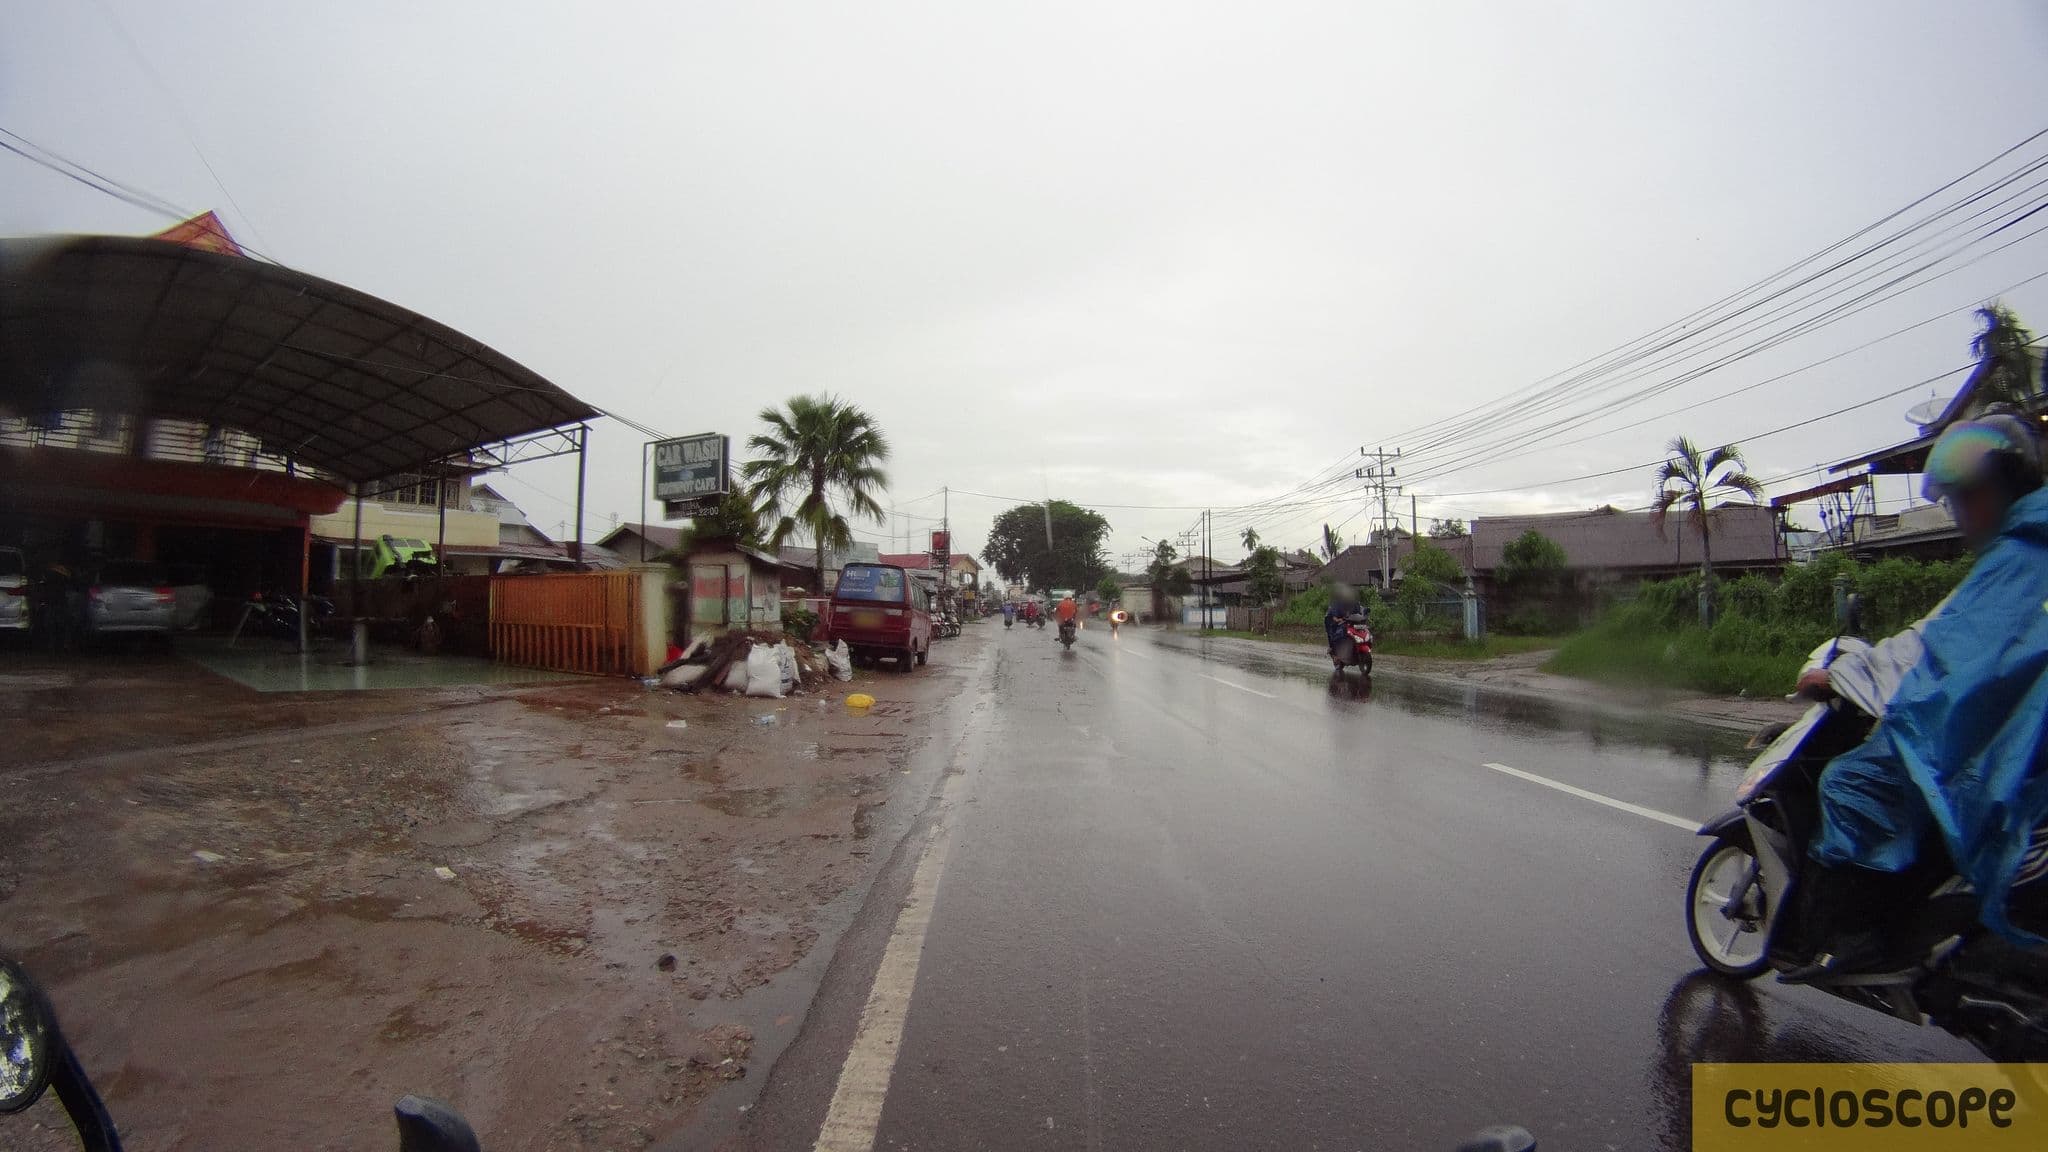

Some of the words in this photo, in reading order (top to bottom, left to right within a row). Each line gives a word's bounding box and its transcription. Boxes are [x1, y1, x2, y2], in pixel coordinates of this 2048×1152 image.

[656, 444, 682, 467] CAR
[683, 439, 719, 463] WASH
[694, 476, 716, 492] CAFE
